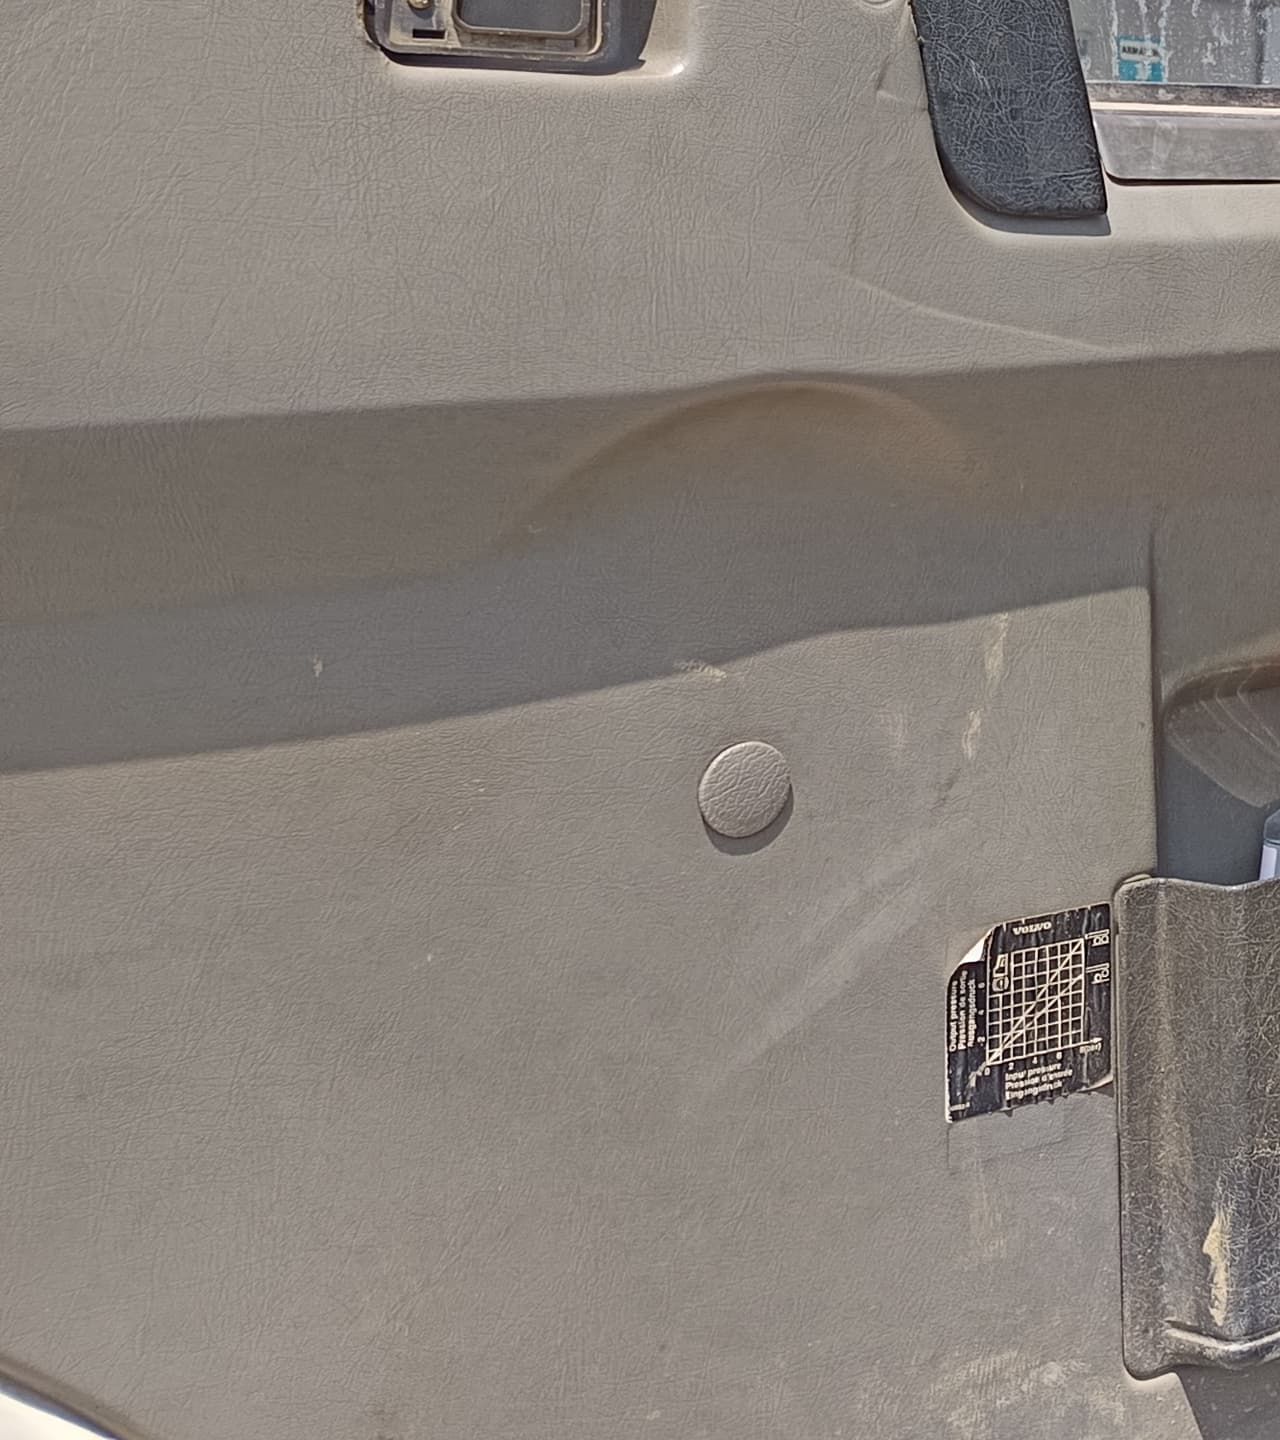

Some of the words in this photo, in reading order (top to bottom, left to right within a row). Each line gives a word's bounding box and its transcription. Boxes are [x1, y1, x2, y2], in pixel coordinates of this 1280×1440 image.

[1012, 921, 1052, 936] VOLVO
[950, 980, 958, 1020] pressure
[959, 996, 967, 1008] de
[949, 1021, 958, 1052] Output
[958, 1010, 967, 1050] Pression
